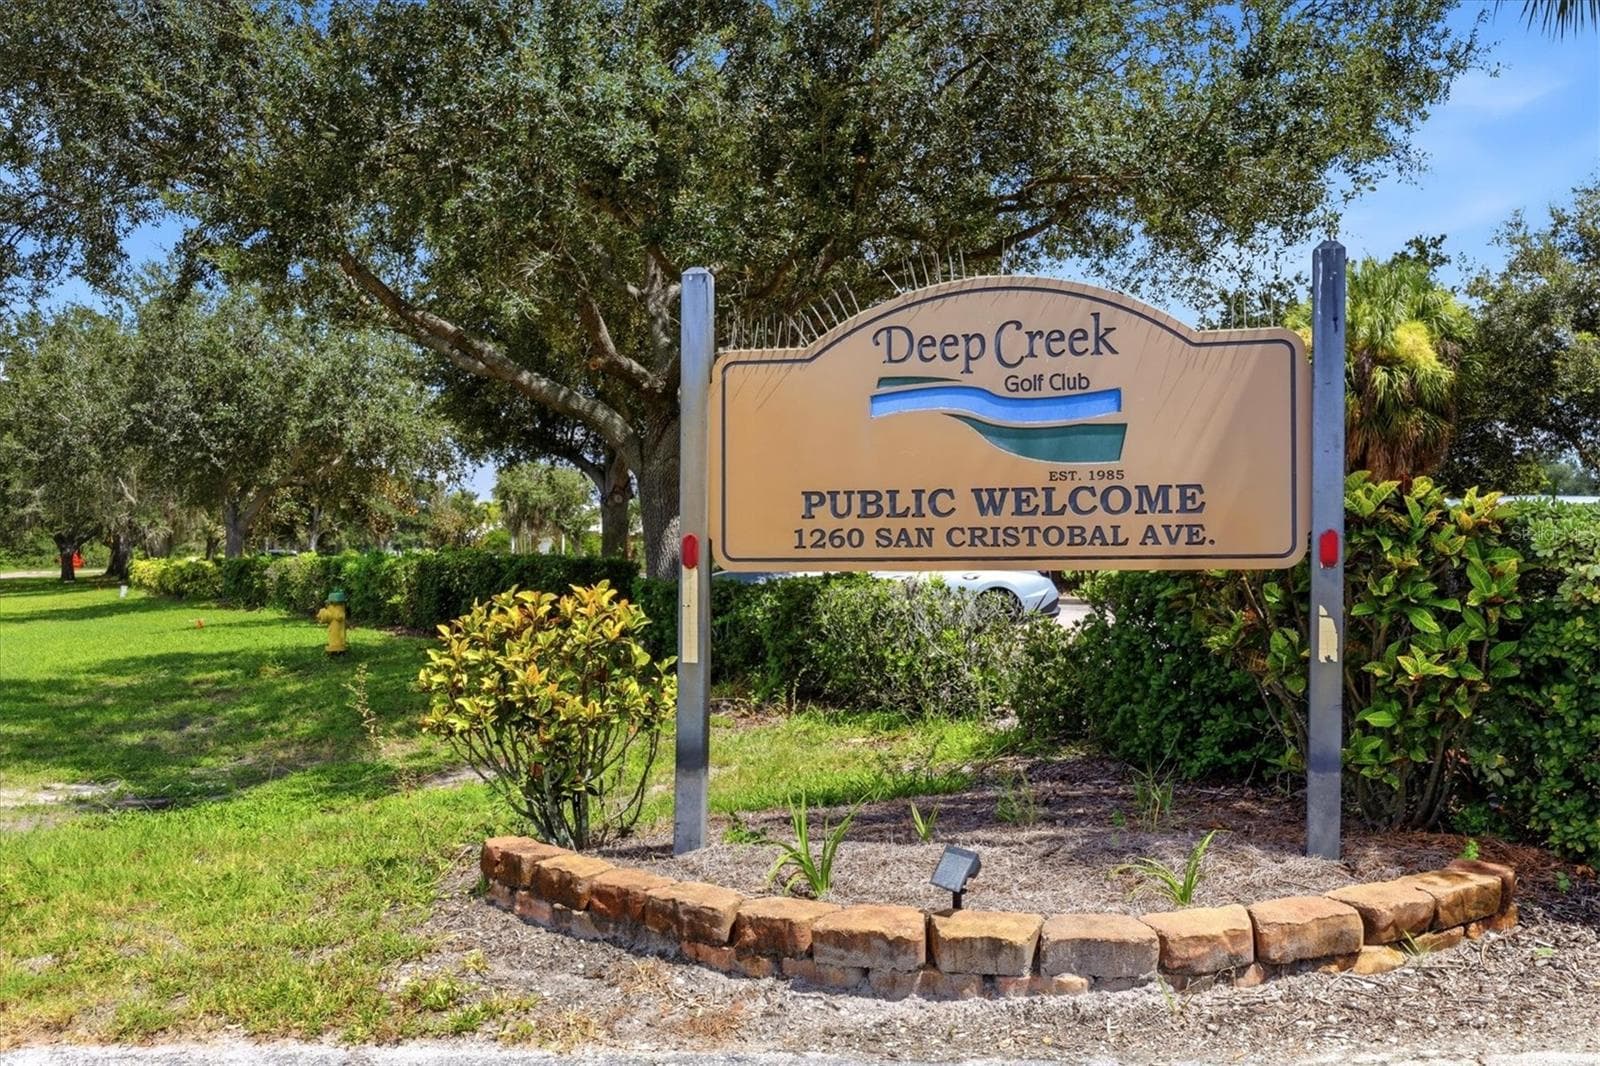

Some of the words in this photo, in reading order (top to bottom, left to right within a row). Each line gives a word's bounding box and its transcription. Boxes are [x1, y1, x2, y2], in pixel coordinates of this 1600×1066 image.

[872, 325, 986, 374] Deep
[994, 312, 1119, 368] Creek
[1004, 373, 1044, 393] Golf
[1049, 373, 1090, 391] Club
[1048, 470, 1082, 482] EST.
[1088, 469, 1125, 481] 1985
[801, 488, 957, 520] PUBLIC
[970, 484, 1206, 517] WELCOME
[793, 527, 865, 550] 1260
[874, 526, 935, 549] SAN
[945, 525, 1129, 548] CRISTOBAL
[1139, 523, 1216, 546] AVE.
